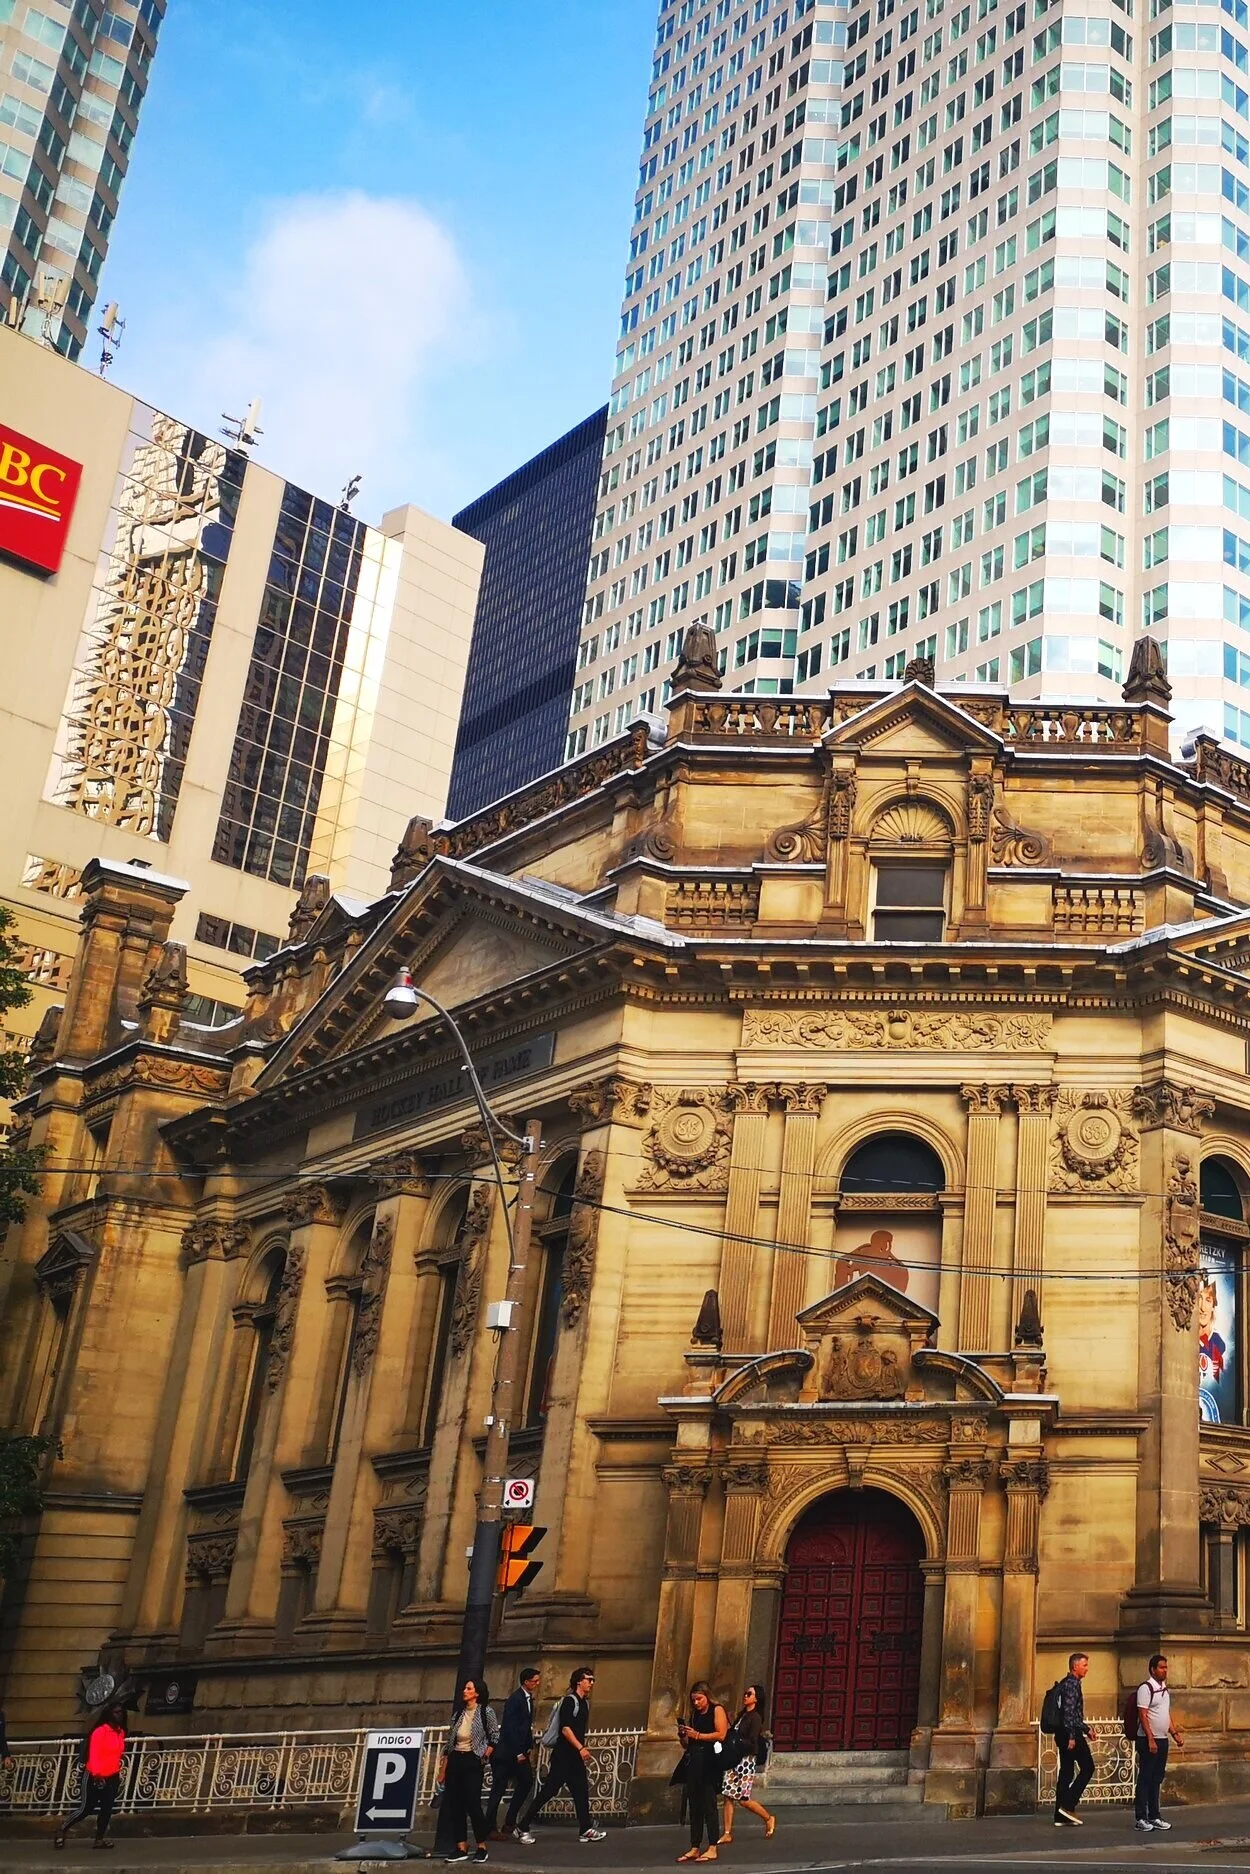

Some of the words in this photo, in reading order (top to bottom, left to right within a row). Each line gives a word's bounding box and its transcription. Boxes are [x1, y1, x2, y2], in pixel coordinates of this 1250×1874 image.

[370, 1090, 426, 1126] HOCKEY
[428, 1076, 465, 1105] HALL
[492, 1050, 532, 1079] FAME
[372, 1752, 407, 1800] P
